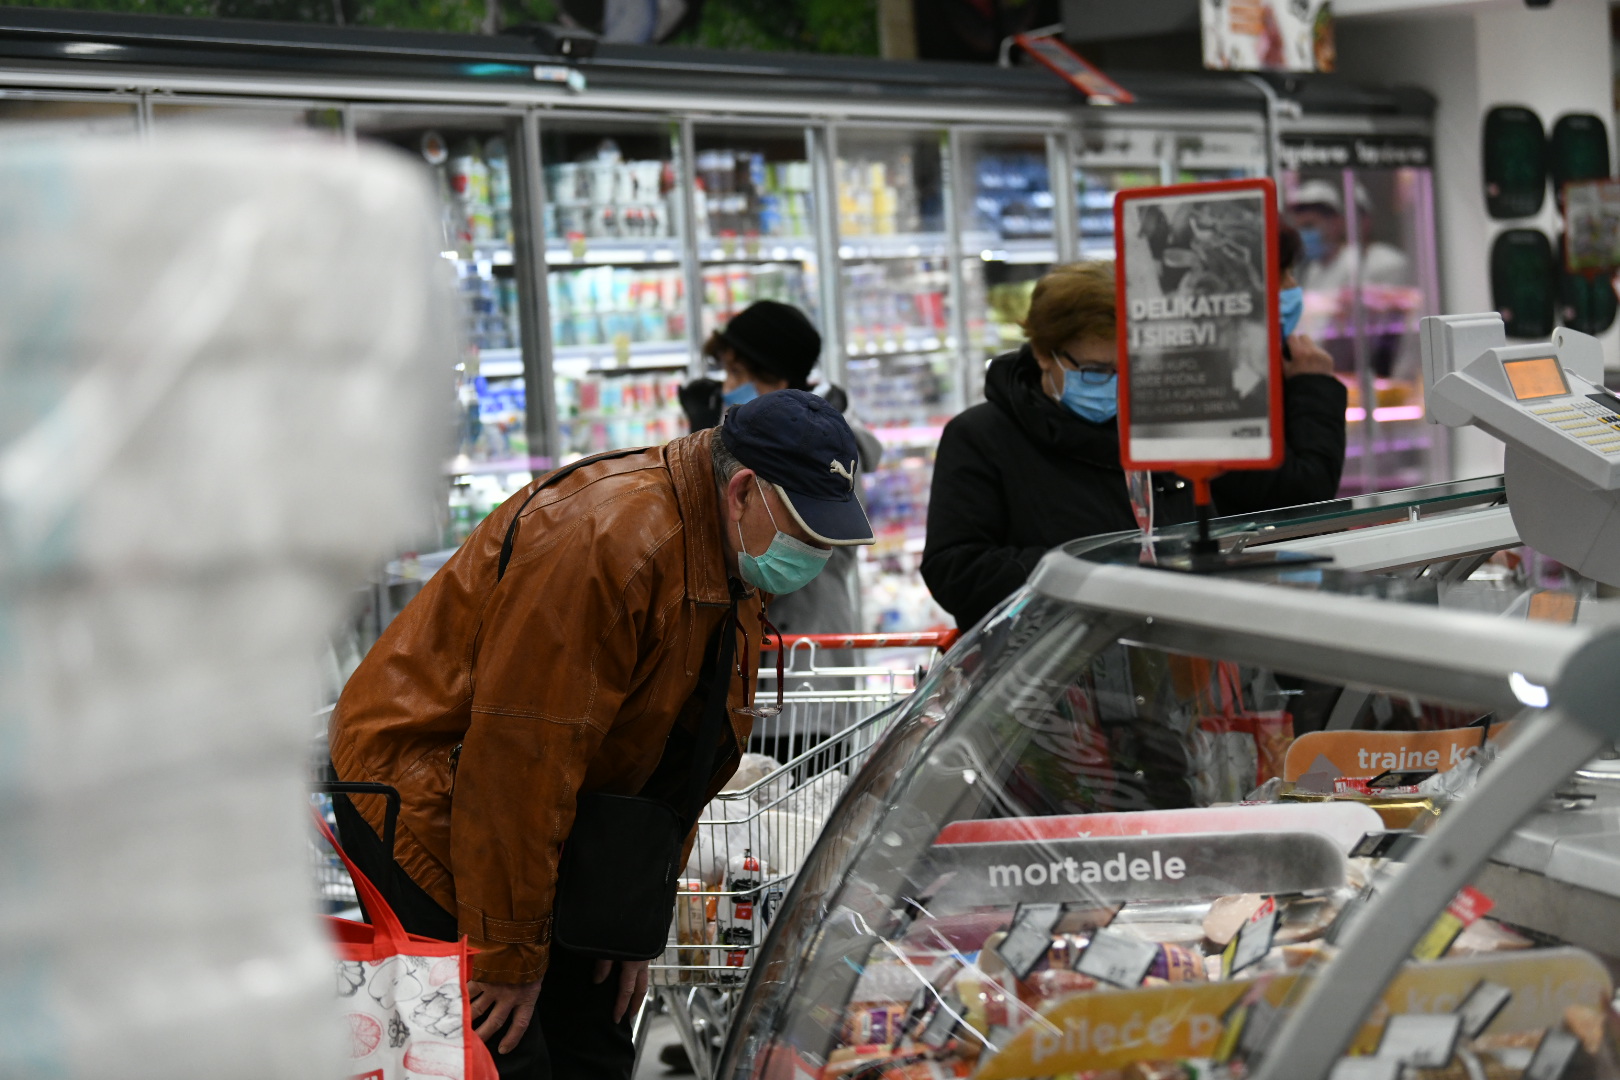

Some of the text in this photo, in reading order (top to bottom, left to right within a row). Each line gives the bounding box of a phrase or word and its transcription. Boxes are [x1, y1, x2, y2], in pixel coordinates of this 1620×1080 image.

[1131, 293, 1253, 320] DELIKATES
[1143, 322, 1216, 347] SIREVI
[988, 851, 1186, 888] mortadele
[1031, 1011, 1176, 1064] pileće
